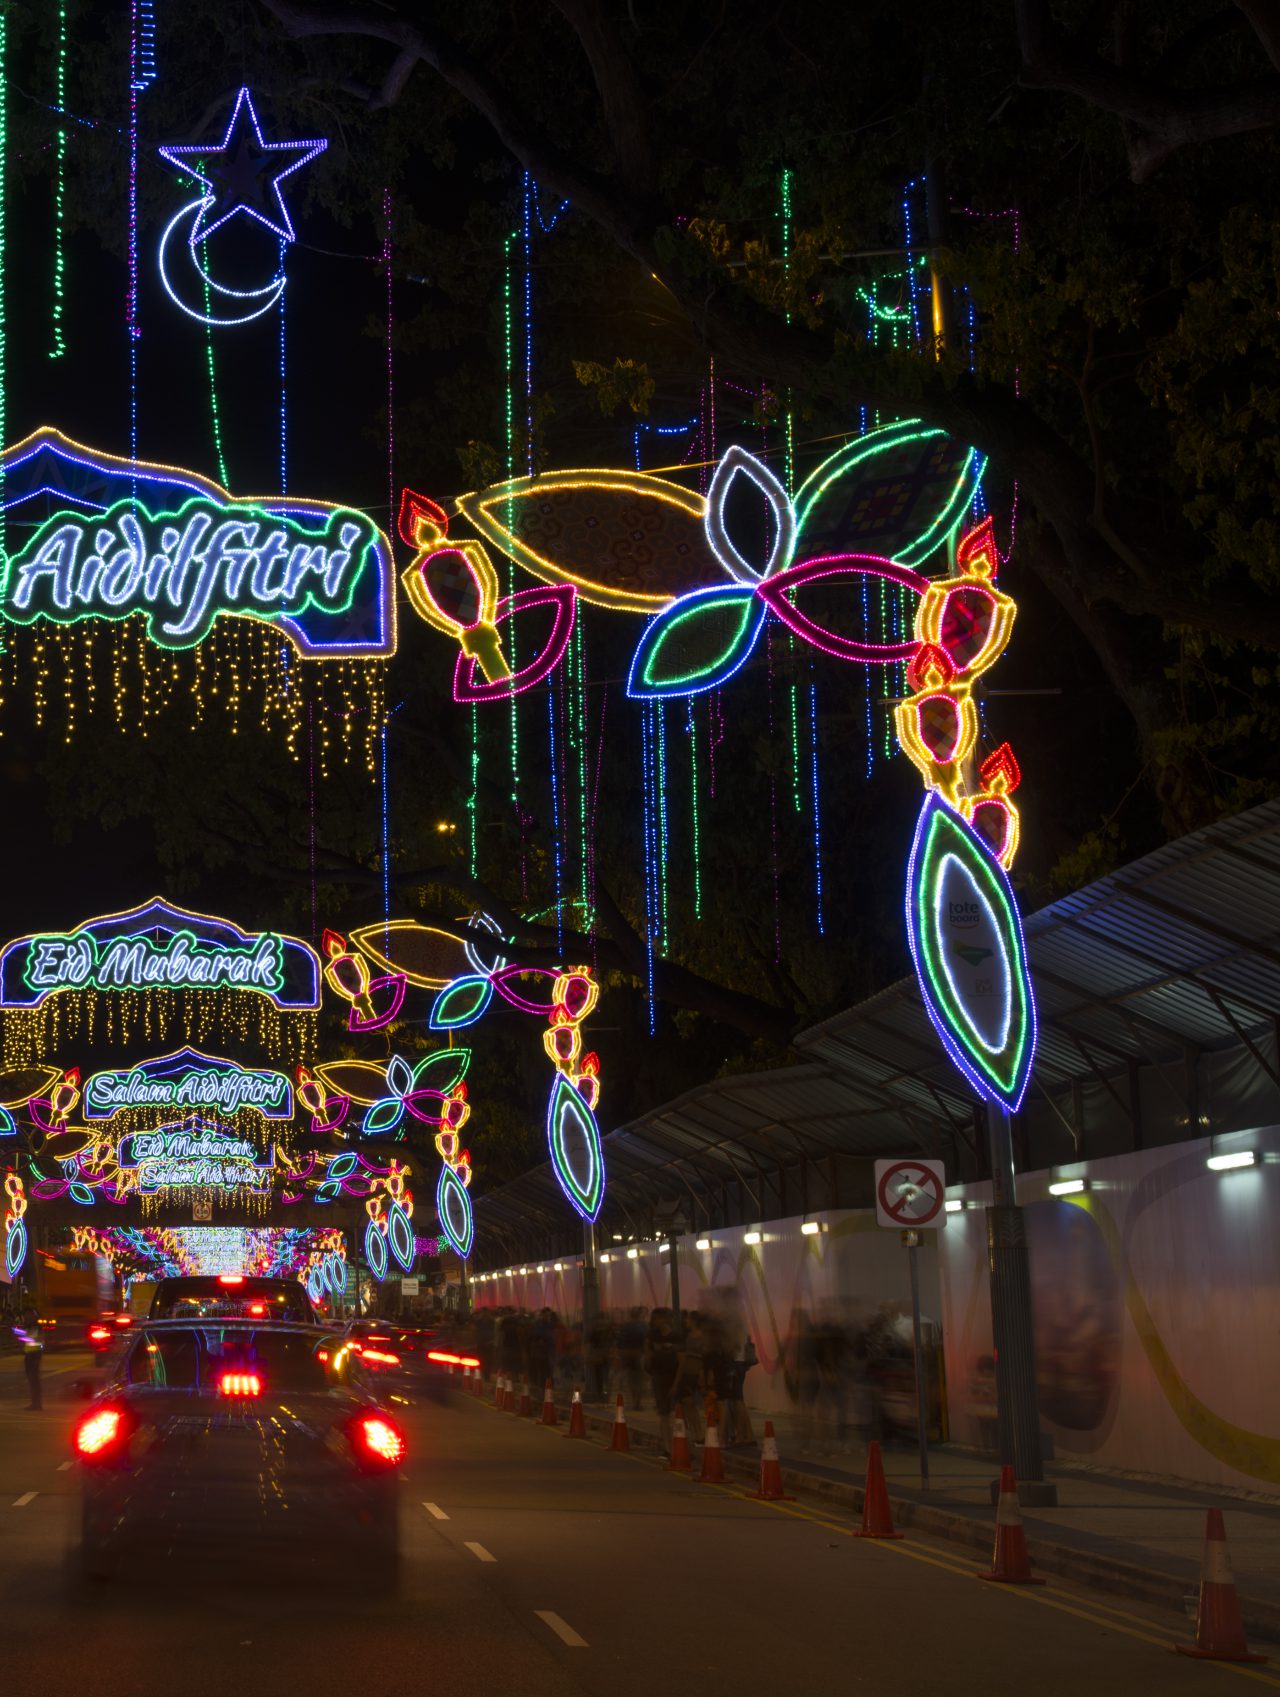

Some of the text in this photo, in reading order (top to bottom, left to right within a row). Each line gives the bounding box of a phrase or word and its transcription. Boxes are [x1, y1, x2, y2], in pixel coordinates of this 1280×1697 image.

[12, 511, 361, 635] Aidilfitri
[949, 901, 979, 913] tote
[31, 939, 276, 986] Eid Mubarak
[91, 1072, 283, 1113] Salam Aidilfitri
[134, 1132, 166, 1157] Eid
